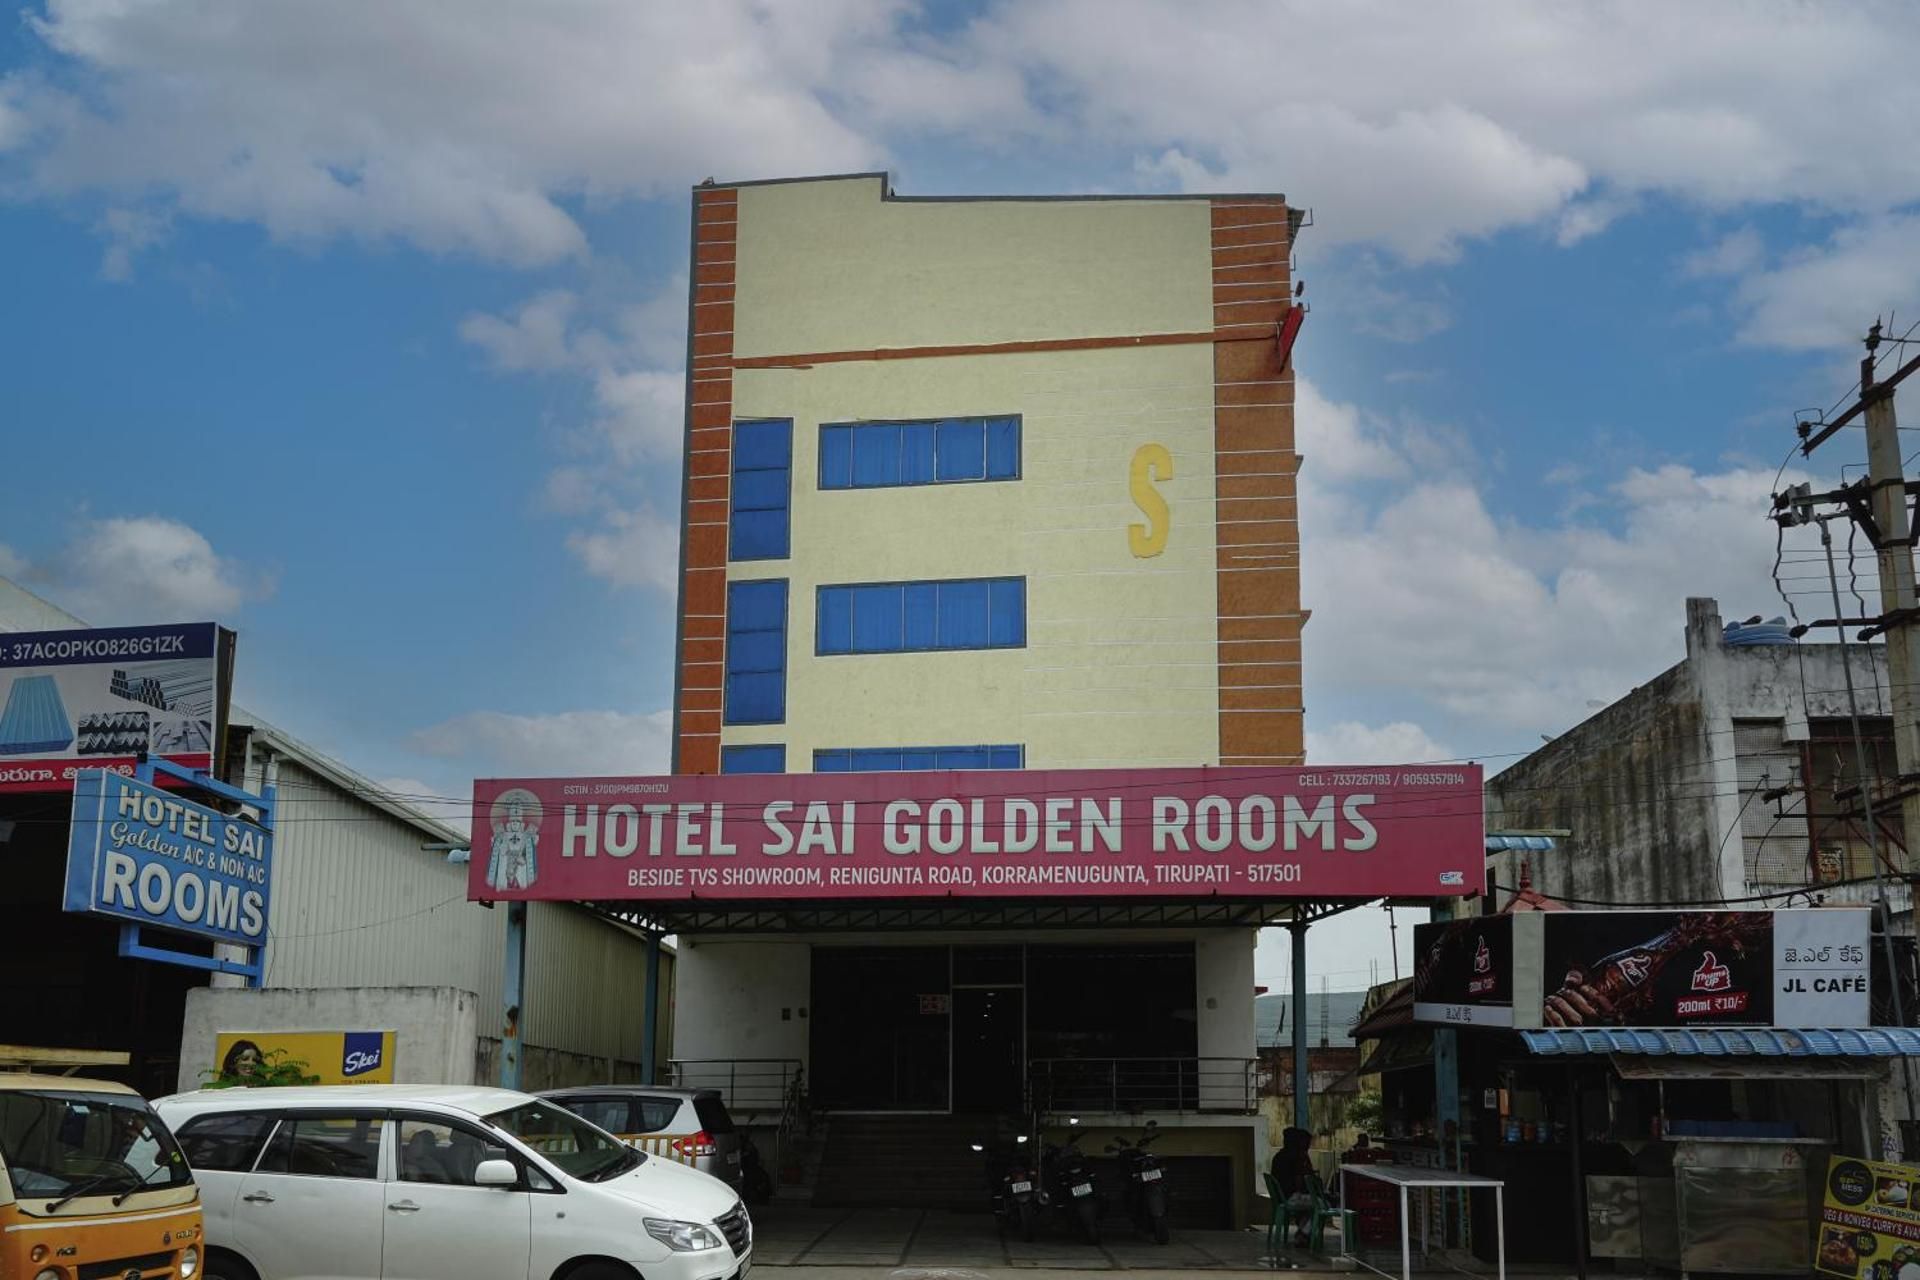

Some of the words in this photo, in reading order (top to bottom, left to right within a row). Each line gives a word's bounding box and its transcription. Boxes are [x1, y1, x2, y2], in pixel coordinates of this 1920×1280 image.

[1128, 443, 1175, 558] S
[1299, 774, 1325, 786] CELL
[119, 784, 215, 847] HOTEL
[223, 823, 264, 861] SAI
[561, 801, 738, 857] HOTEL
[761, 800, 856, 856] SAI
[882, 797, 1122, 855] GOLDEN
[1152, 793, 1378, 853] ROOMS
[109, 821, 179, 858] Golden
[207, 853, 215, 870] &
[102, 850, 264, 937] ROOMS
[628, 868, 684, 886] BESIDE
[688, 868, 717, 885] TVS
[722, 867, 825, 888] SHOWROOM,
[830, 866, 923, 885] RENIGUNTA
[928, 866, 977, 887] ROAD,
[982, 864, 1149, 887] KORRAMENUGUNTA,
[1154, 864, 1230, 883] TIRUPATI
[1247, 863, 1301, 882] 517501
[1783, 978, 1807, 993] JL
[1814, 975, 1866, 993] CAFÉ
[1677, 1000, 1711, 1014] 200ml
[345, 1049, 380, 1072] Skei
